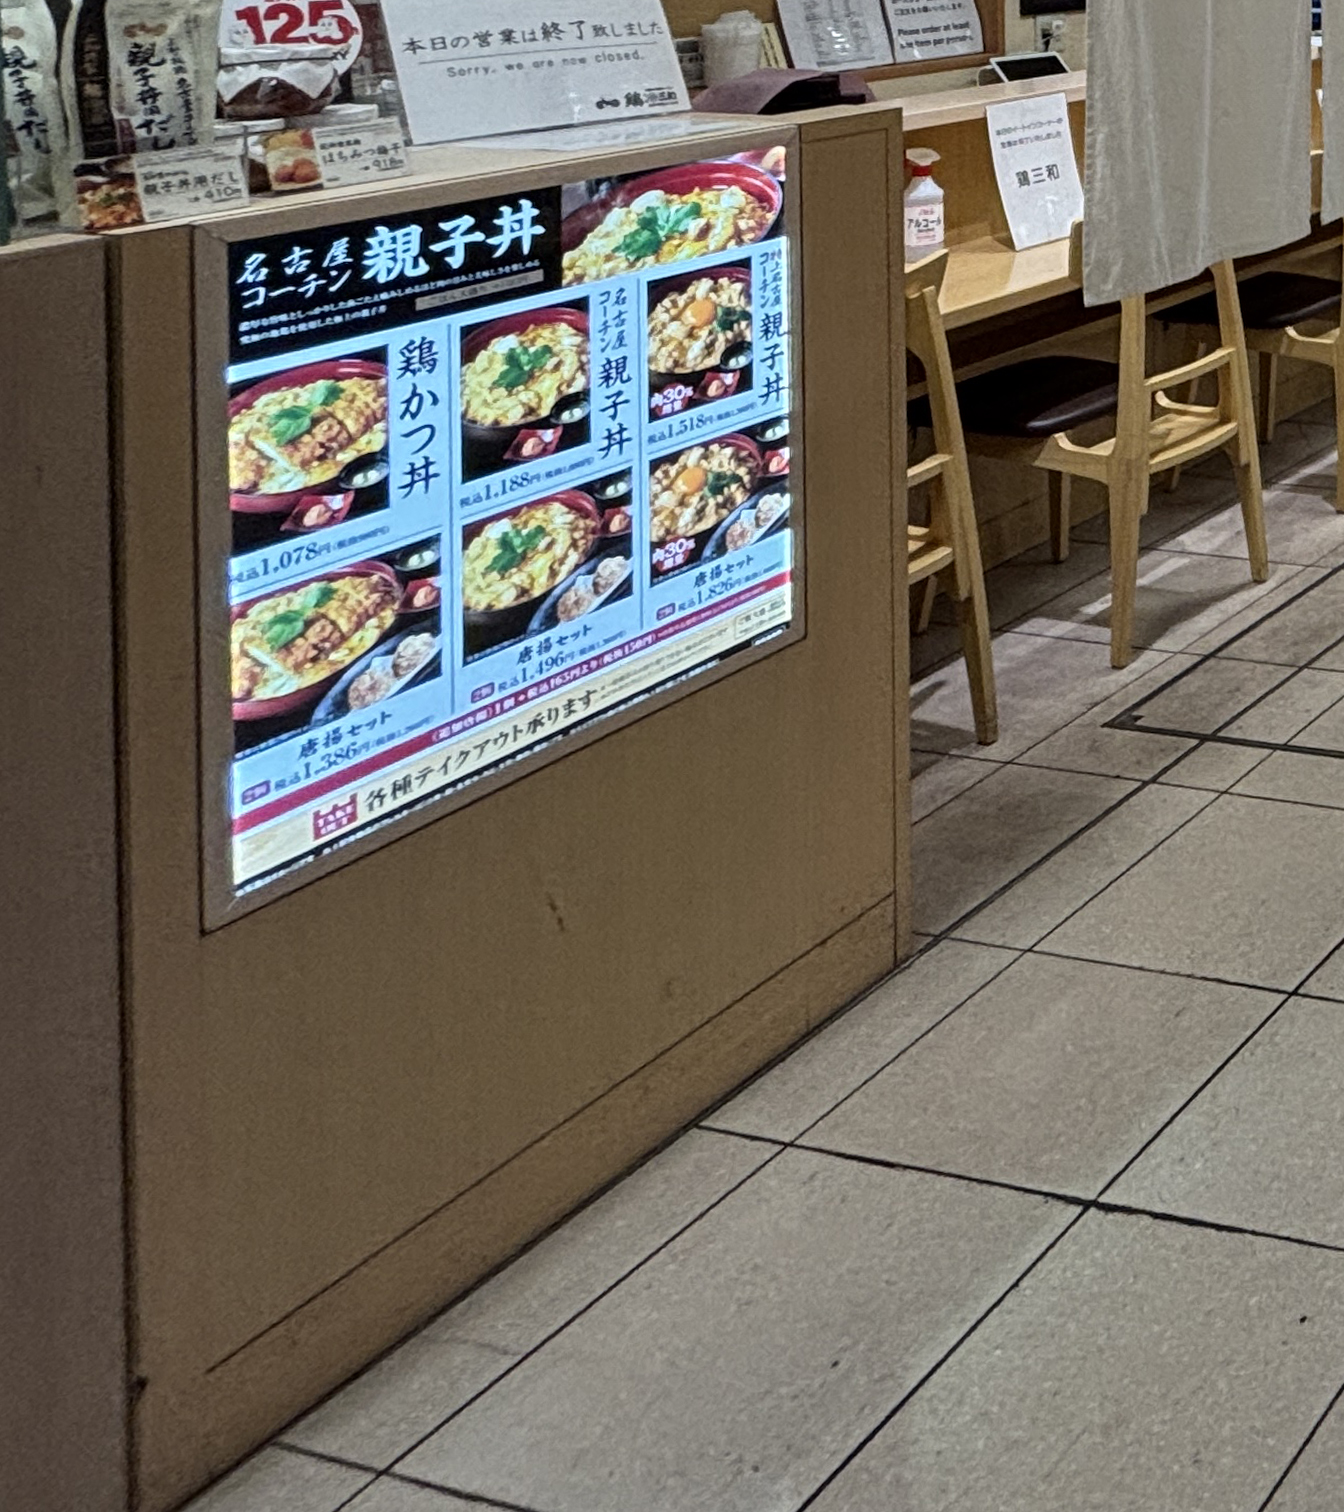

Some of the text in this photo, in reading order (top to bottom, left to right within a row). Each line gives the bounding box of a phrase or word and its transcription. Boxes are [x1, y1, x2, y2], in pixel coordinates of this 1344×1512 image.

[235, 0, 348, 46] 125
[402, 19, 664, 55] 本日の営業は終了致しました
[505, 61, 524, 71] we
[532, 57, 555, 69] are
[595, 48, 645, 65] closed.
[1016, 164, 1060, 189] 鶏三和
[362, 199, 547, 284] 親子丼
[907, 217, 942, 229] アルコール
[236, 236, 354, 285] 名古屋
[758, 252, 771, 309] コーチン
[241, 269, 353, 309] コーチン
[597, 290, 613, 353] コーチン
[611, 287, 629, 355] 名古屋
[758, 310, 788, 406] 親子丼
[396, 335, 441, 499] 鶏かつ丼
[597, 355, 633, 459] 親子丼
[516, 623, 593, 666] 唐揚セット
[297, 710, 394, 762] 唐揚セット
[364, 689, 598, 813] 各種テイクアウト承ります
[316, 803, 356, 828] TAKE
